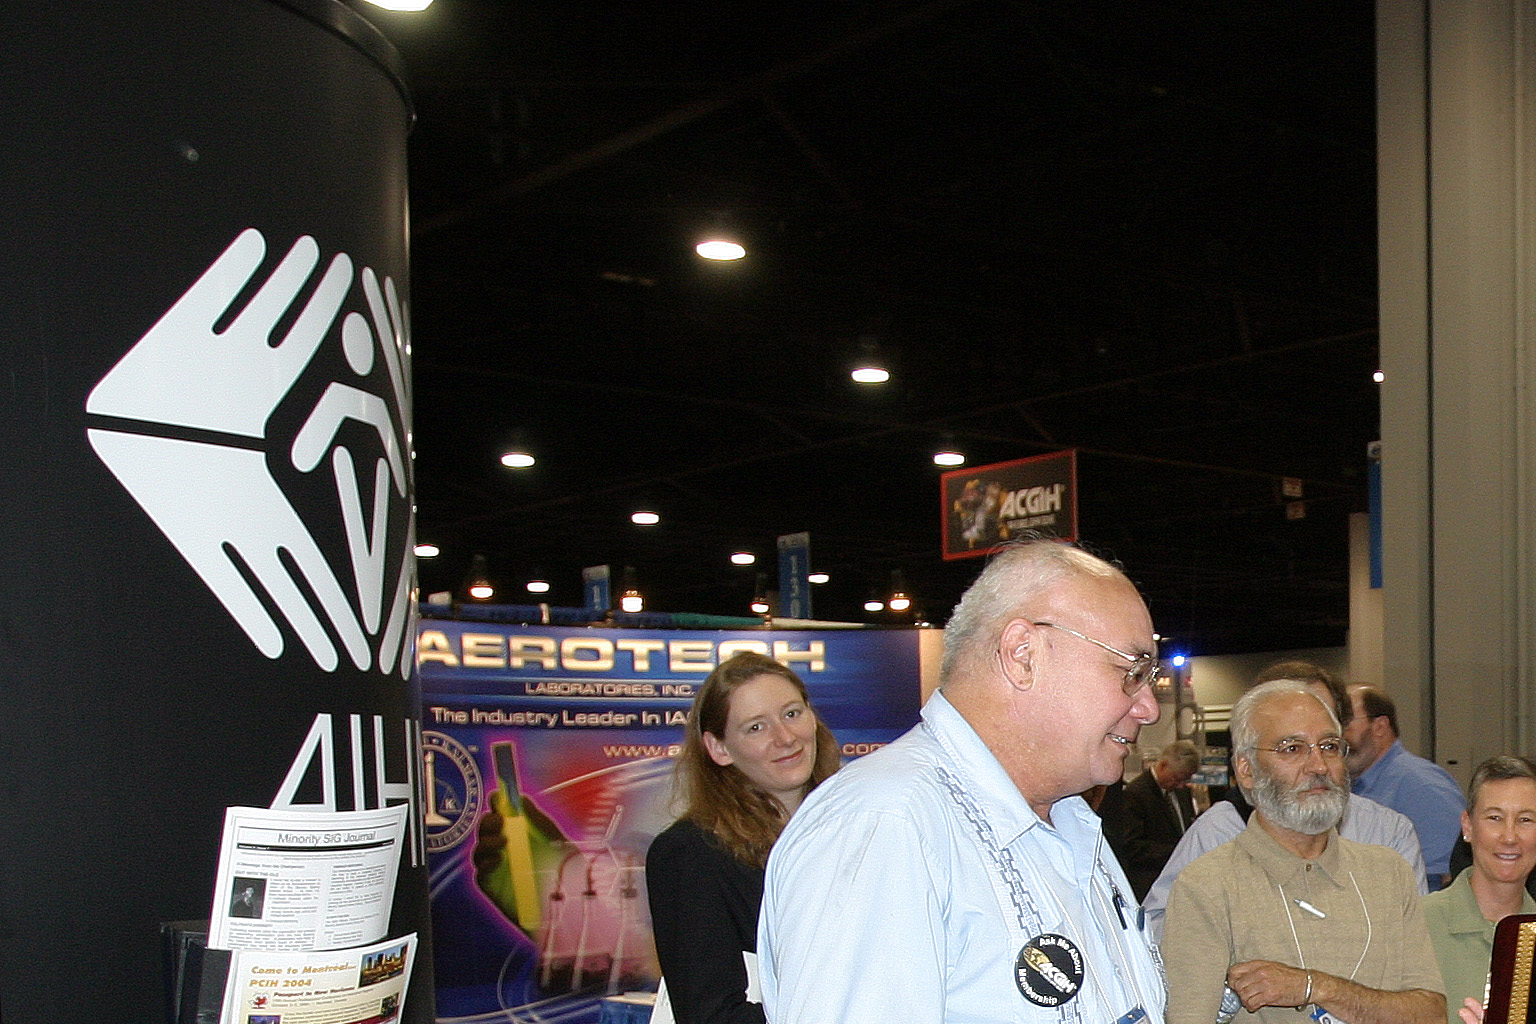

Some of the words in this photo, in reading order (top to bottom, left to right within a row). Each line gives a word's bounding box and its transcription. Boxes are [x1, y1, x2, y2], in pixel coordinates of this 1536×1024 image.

[417, 630, 827, 673] AEROTECH
[661, 683, 695, 696] INC.
[431, 706, 469, 725] The
[472, 708, 558, 728] Industry
[562, 709, 638, 727] Leader
[641, 711, 662, 725] In
[269, 713, 427, 867] AIH
[278, 832, 321, 846] Minority
[344, 831, 376, 843] Journal
[1039, 936, 1056, 947] Ask
[1056, 938, 1070, 951] Me
[1067, 948, 1083, 975] About
[251, 966, 283, 975] Come
[286, 966, 299, 975] to
[282, 978, 313, 988] 2004
[1018, 968, 1058, 1006] Membership
